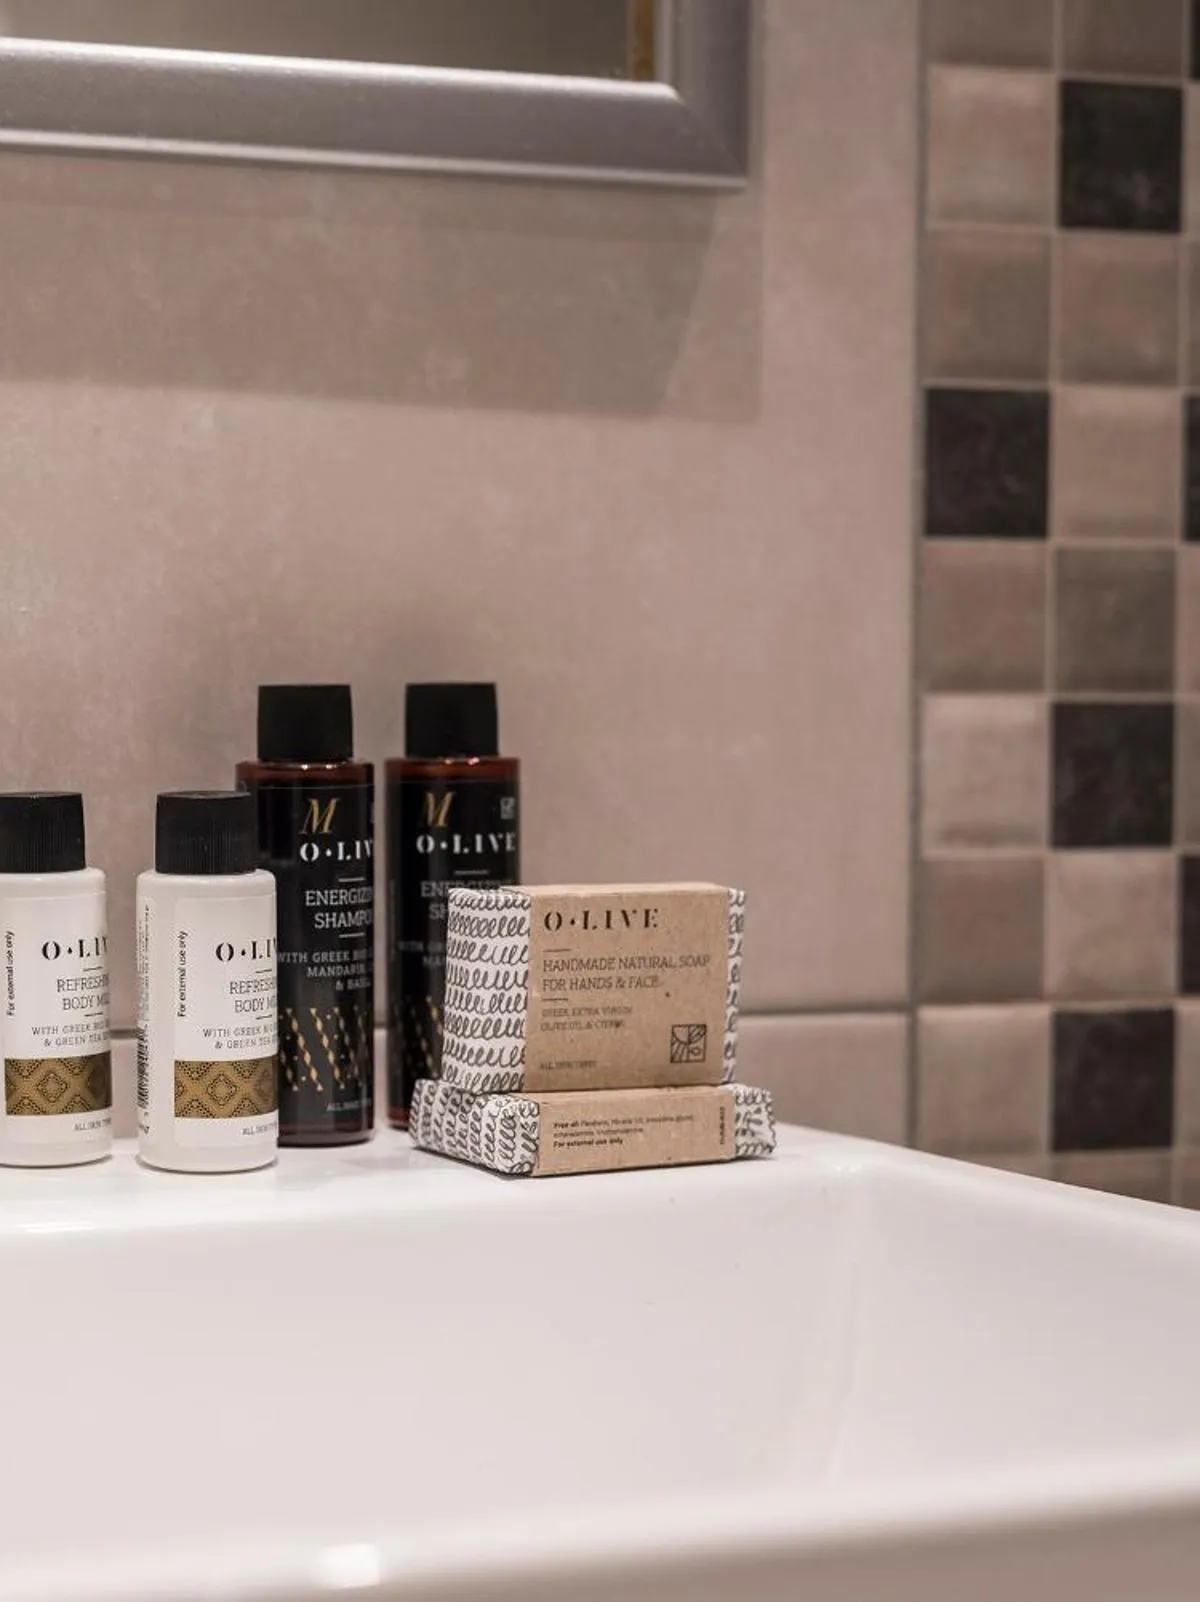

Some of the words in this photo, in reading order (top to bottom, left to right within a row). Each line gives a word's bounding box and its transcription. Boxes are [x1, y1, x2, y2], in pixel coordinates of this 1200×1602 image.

[299, 798, 339, 834] M
[543, 957, 616, 972] HANDMADE
[619, 955, 676, 970] NATURAL
[679, 954, 710, 968] SOAP
[543, 978, 567, 992] FOR
[570, 976, 612, 990] HANDS
[628, 975, 659, 989] FACE
[62, 995, 94, 1010] BODY
[235, 998, 264, 1013] BODY
[32, 1026, 58, 1035] WITH
[203, 1029, 229, 1038] WITH
